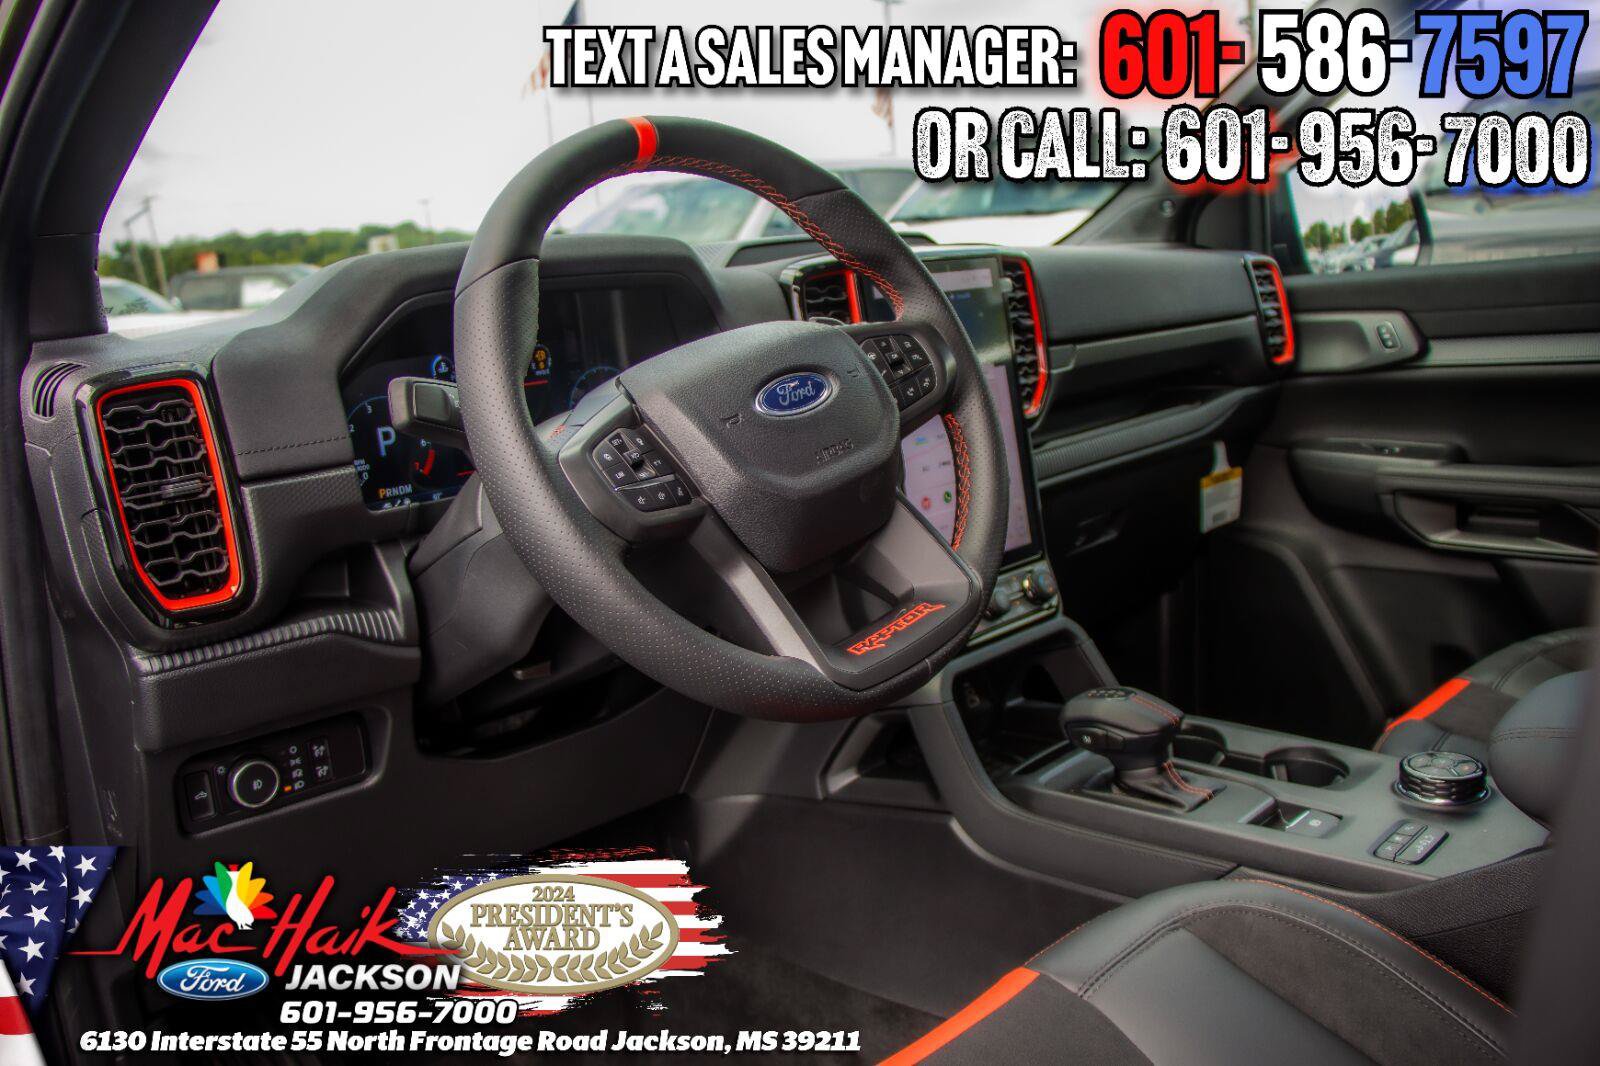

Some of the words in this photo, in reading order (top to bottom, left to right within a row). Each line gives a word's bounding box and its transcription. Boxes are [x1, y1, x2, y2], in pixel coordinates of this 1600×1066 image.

[777, 380, 815, 406] Ford
[376, 425, 397, 457] P
[847, 602, 946, 655] RAPTOR
